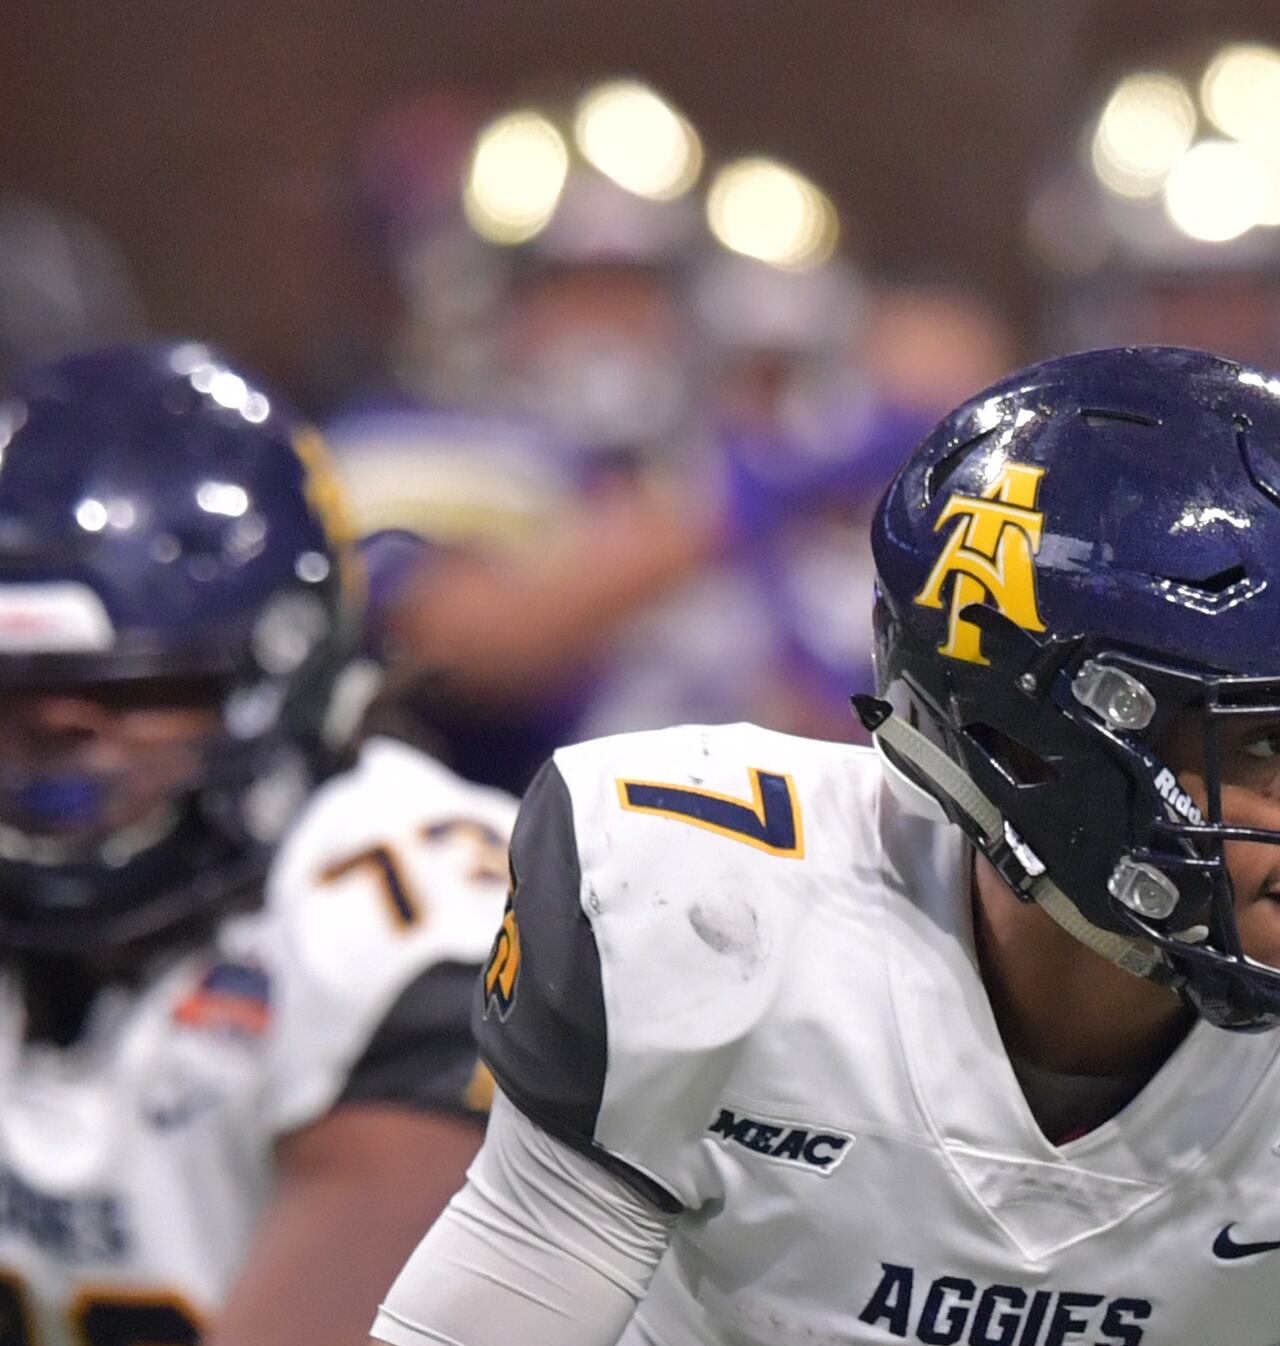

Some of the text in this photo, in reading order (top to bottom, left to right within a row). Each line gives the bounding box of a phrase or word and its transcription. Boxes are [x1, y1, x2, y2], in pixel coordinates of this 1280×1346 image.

[616, 767, 805, 860] 7
[1153, 767, 1207, 827] Ridd
[709, 1109, 848, 1170] MEAC
